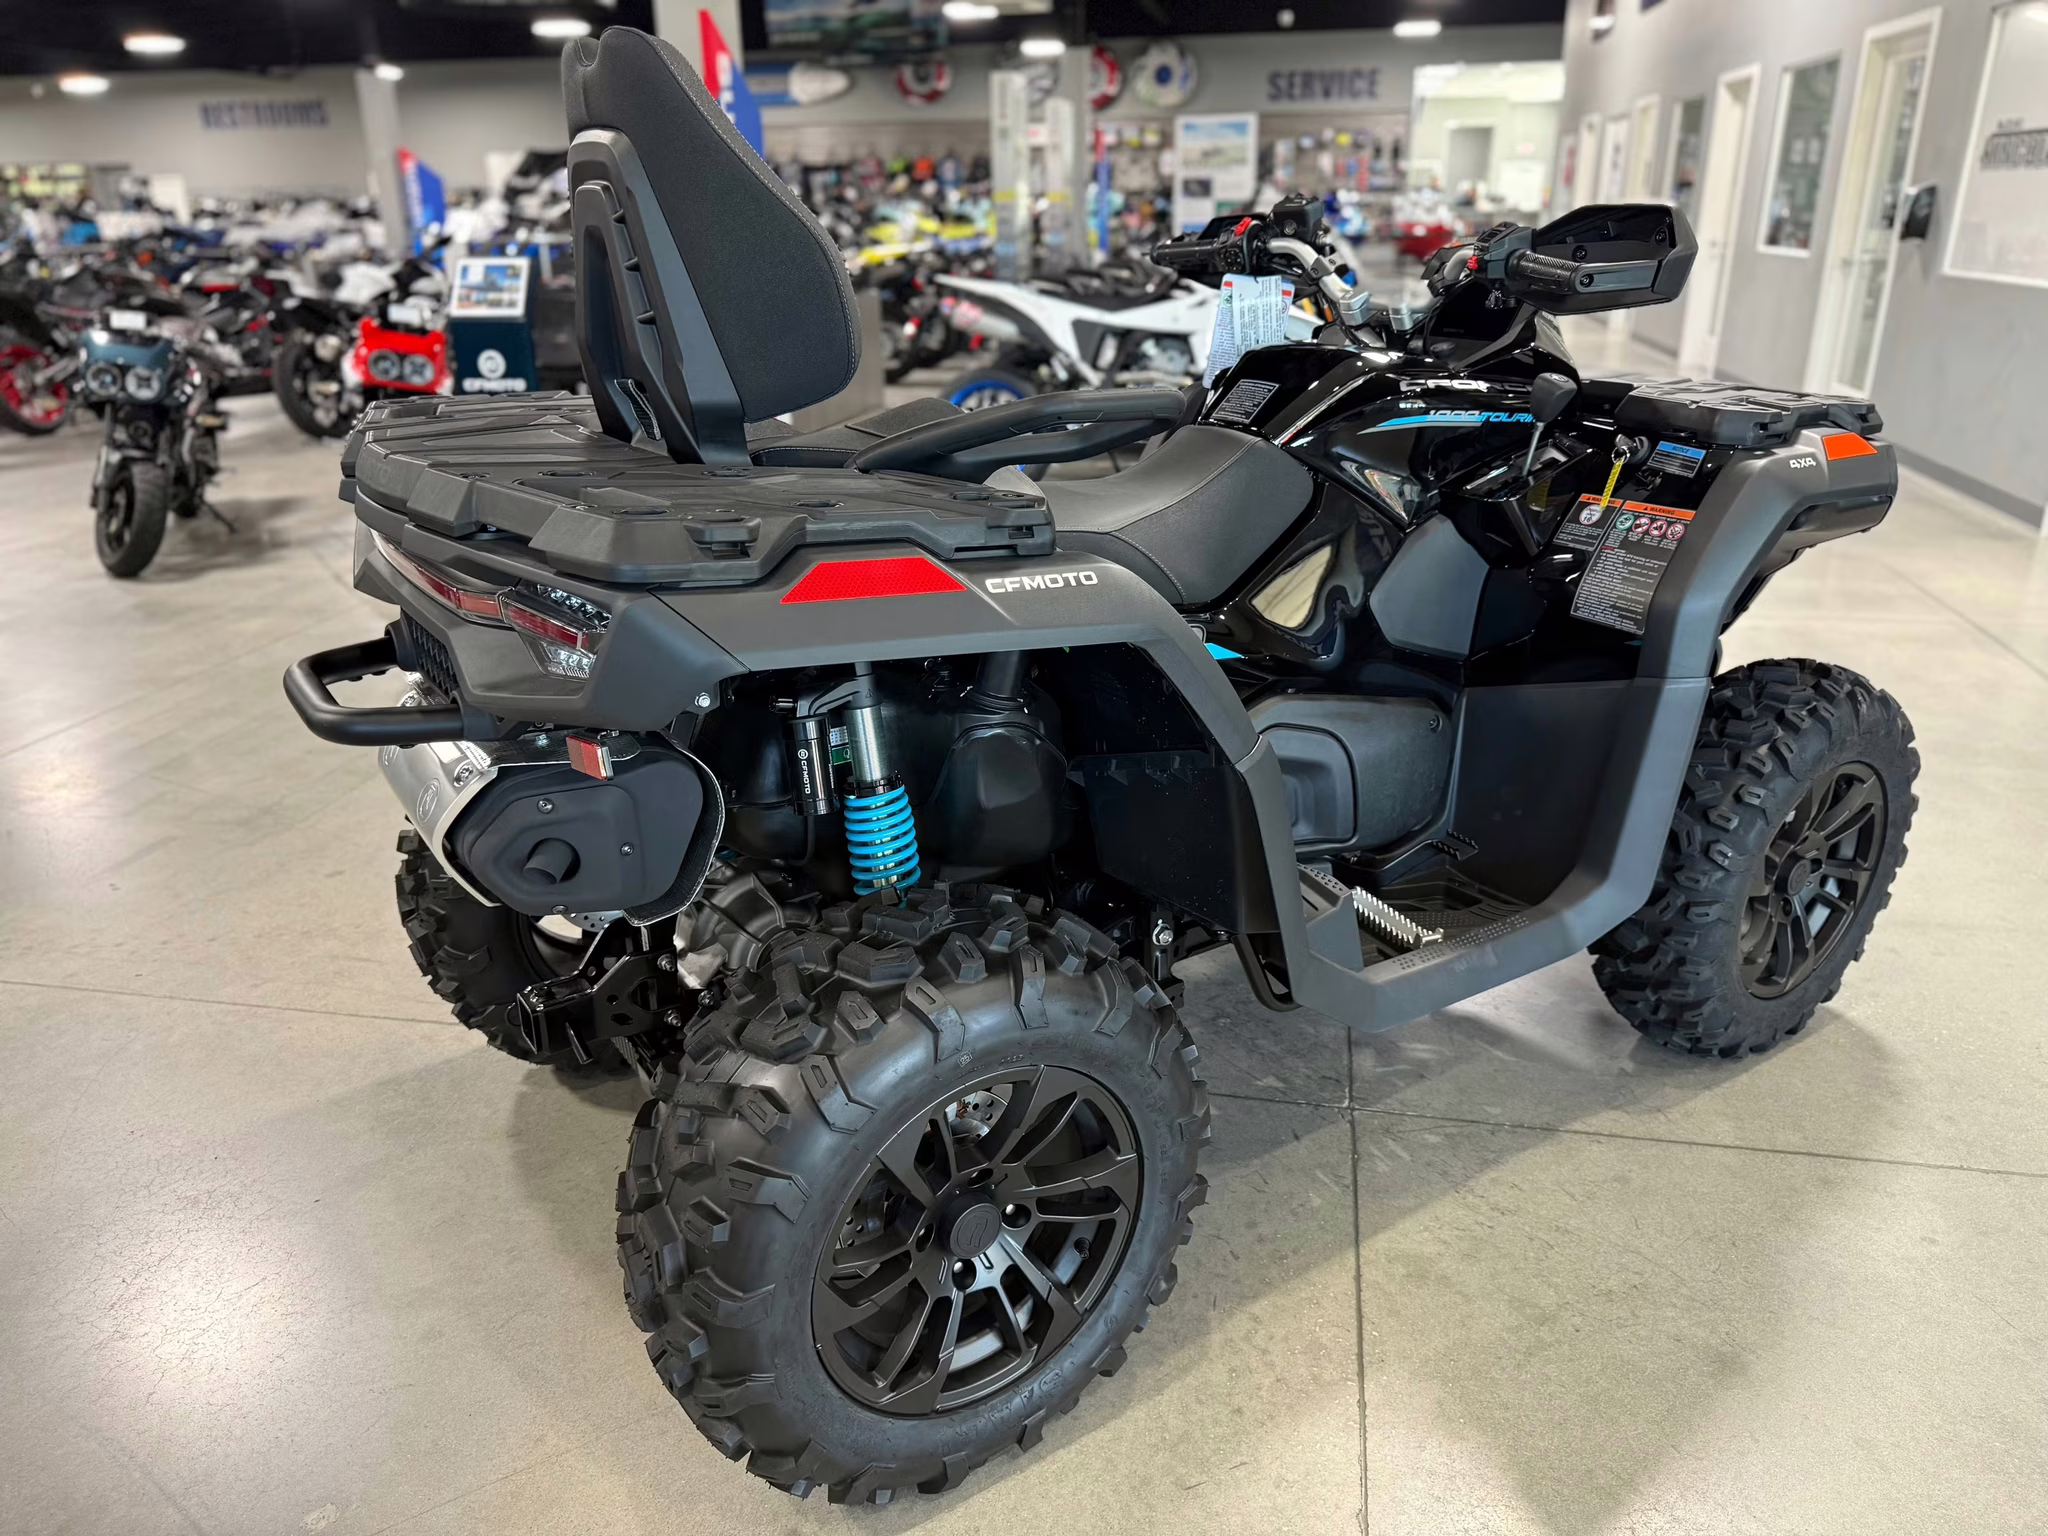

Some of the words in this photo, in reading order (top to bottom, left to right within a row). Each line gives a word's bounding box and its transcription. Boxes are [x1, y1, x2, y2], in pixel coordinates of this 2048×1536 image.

[1266, 67, 1379, 101] SERVICE
[1789, 457, 1817, 469] 4X4
[1648, 507, 1675, 516] WARNING
[985, 571, 1098, 594] CFMOTO
[801, 760, 811, 794] CFMOTO
